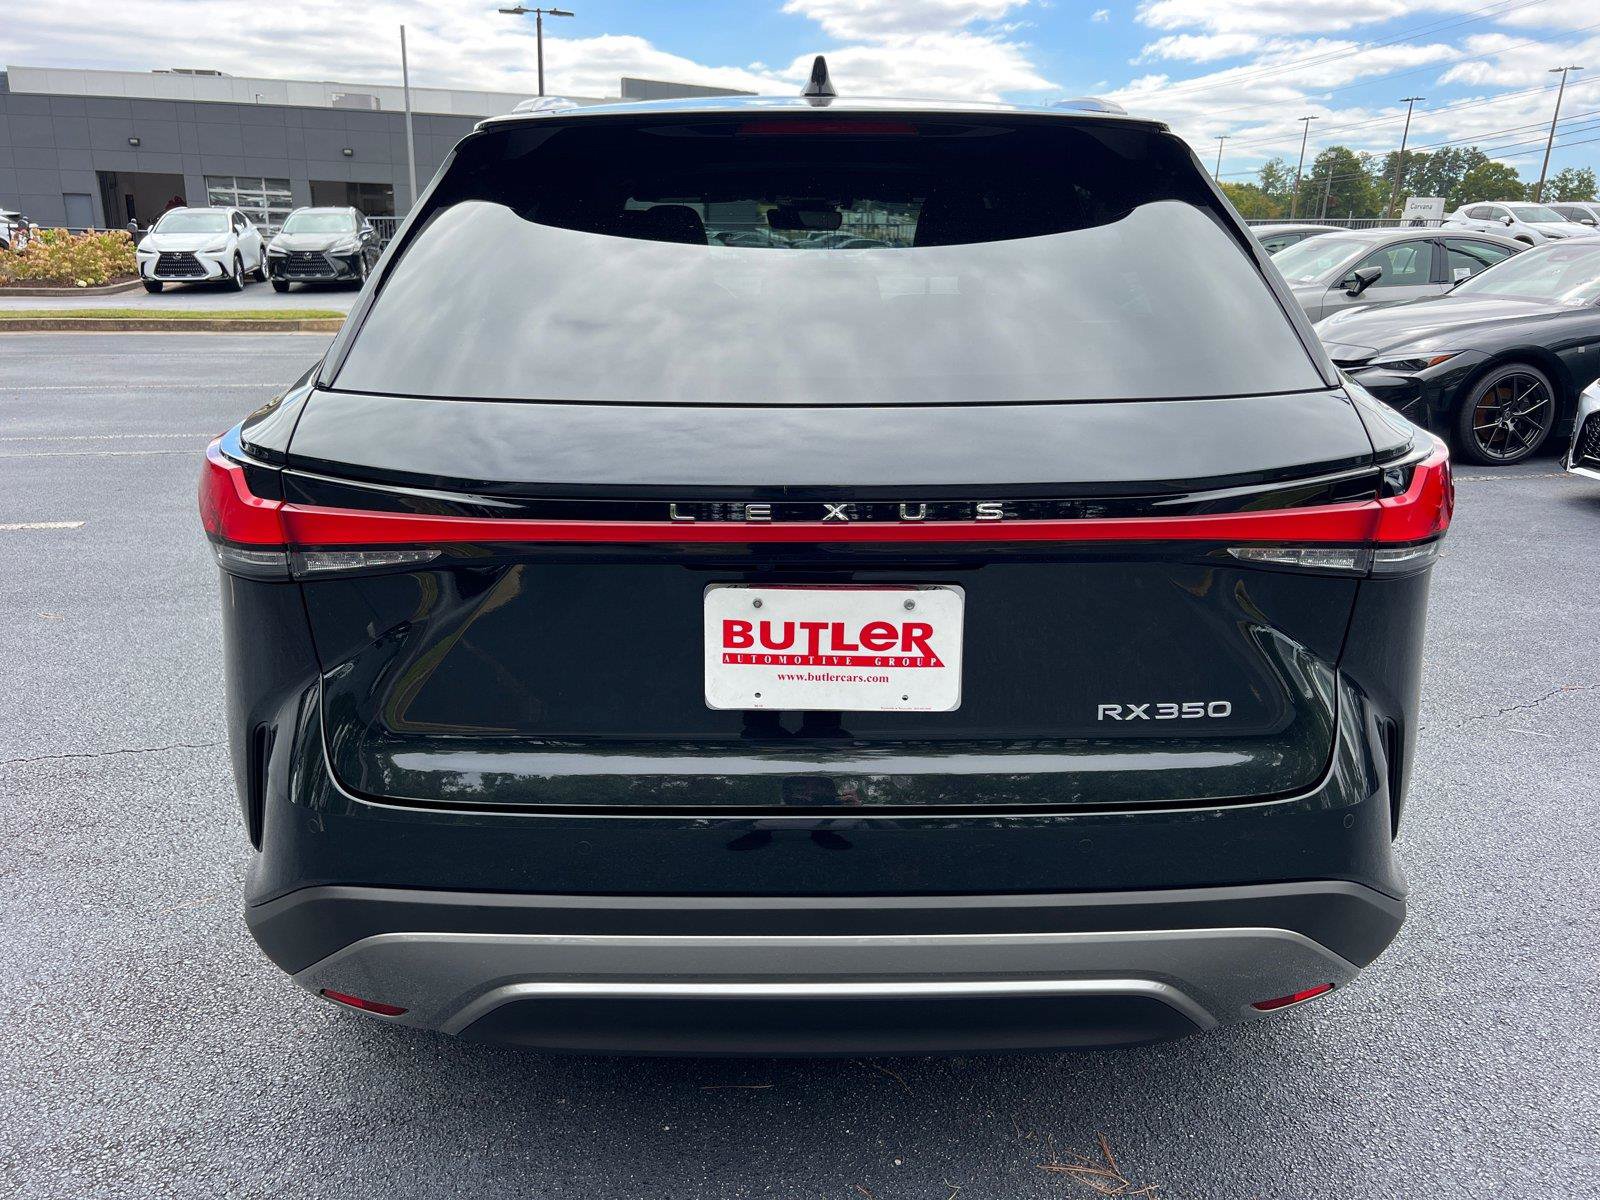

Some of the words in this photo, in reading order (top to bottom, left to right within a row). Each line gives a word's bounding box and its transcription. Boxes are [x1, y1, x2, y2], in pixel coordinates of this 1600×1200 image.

[670, 503, 1004, 521] LEXUS
[723, 653, 853, 666] AUTOMOTIVE
[874, 657, 938, 668] GROUP
[777, 672, 890, 683] www.butlercars.com
